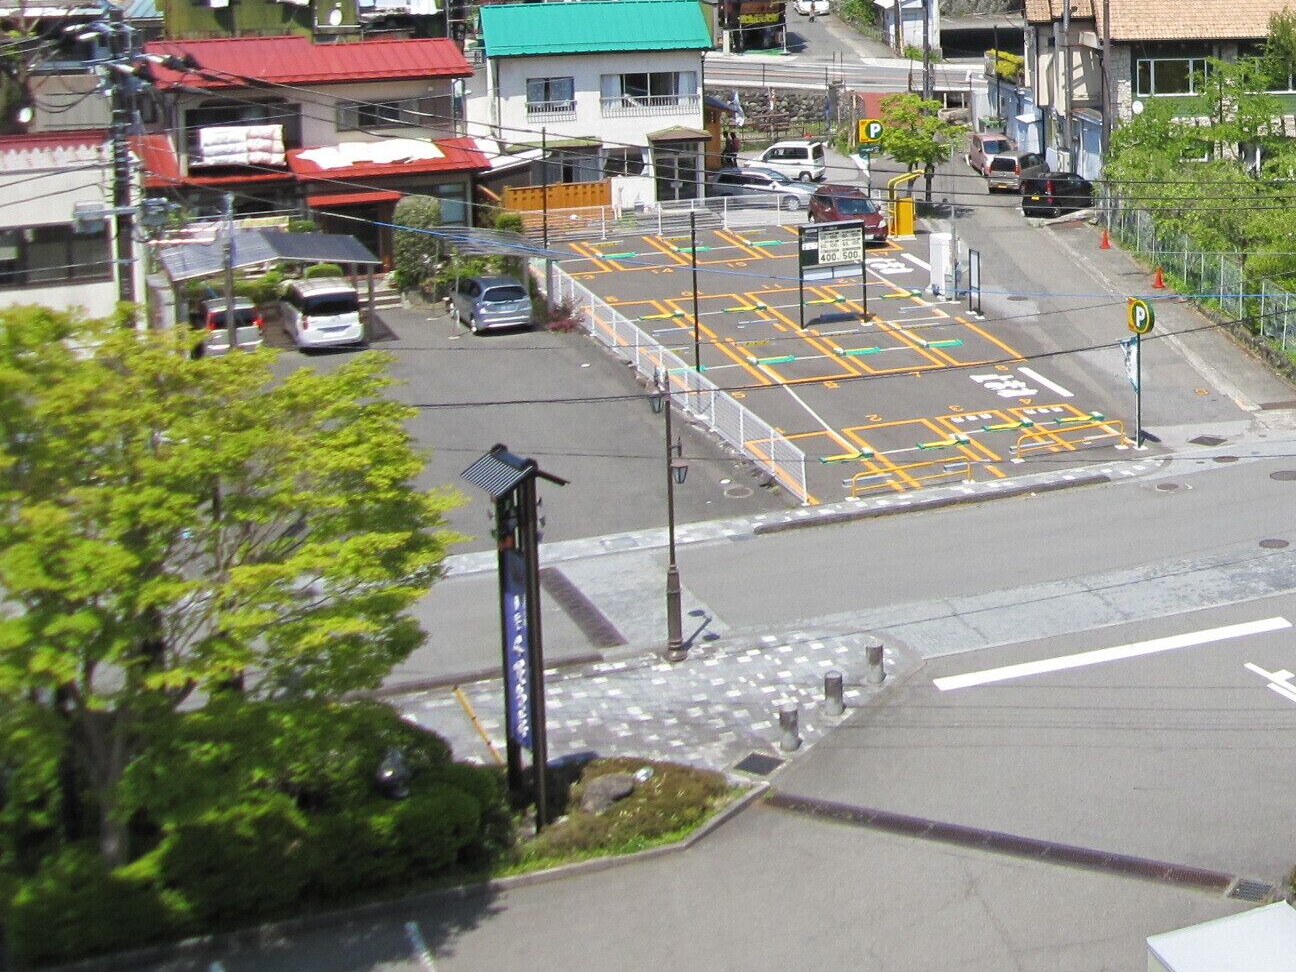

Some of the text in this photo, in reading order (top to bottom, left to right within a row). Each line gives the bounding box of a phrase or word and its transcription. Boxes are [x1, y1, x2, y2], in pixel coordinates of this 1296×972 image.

[870, 123, 881, 138] P
[820, 253, 837, 263] 400
[842, 251, 859, 260] 500
[1135, 306, 1146, 327] P
